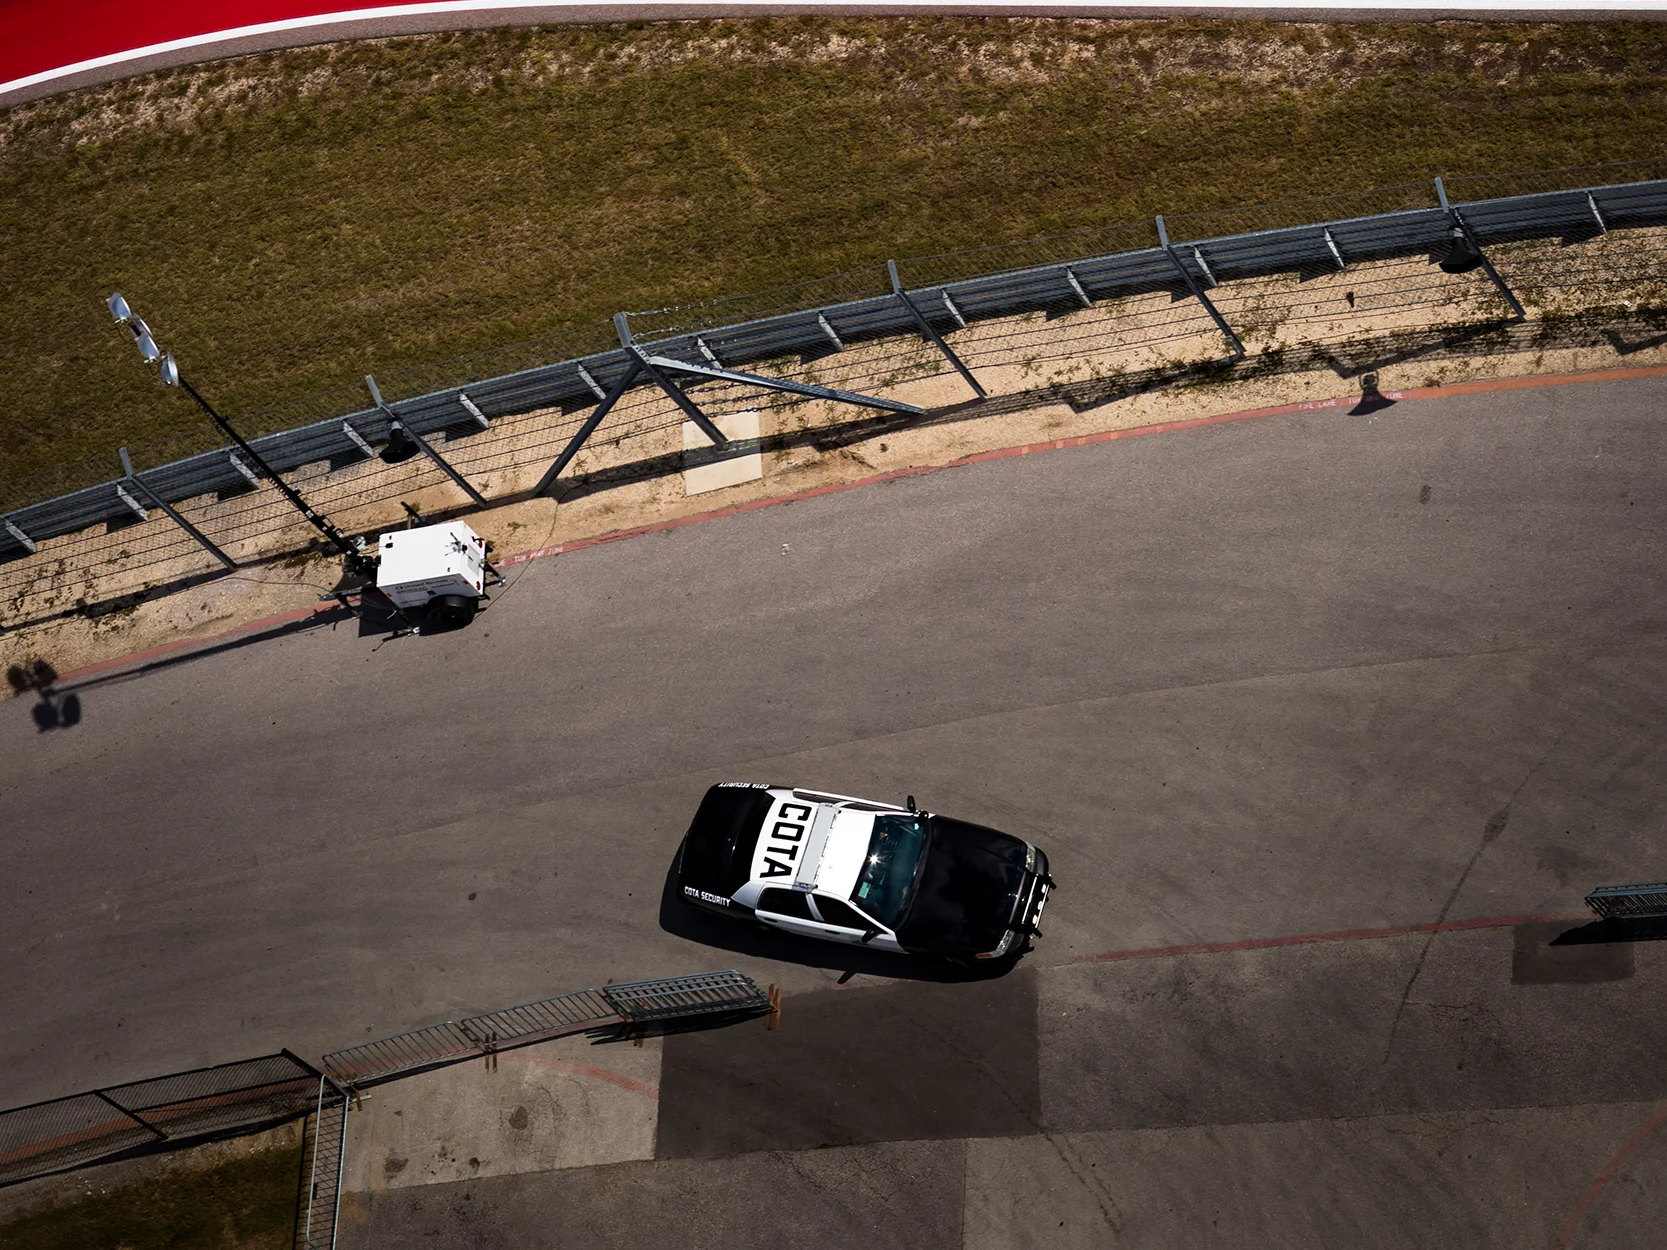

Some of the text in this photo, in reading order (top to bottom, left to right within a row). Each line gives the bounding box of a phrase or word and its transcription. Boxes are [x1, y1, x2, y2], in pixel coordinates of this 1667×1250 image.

[759, 803, 812, 878] COTA
[684, 886, 731, 906] COTA SECURITY
